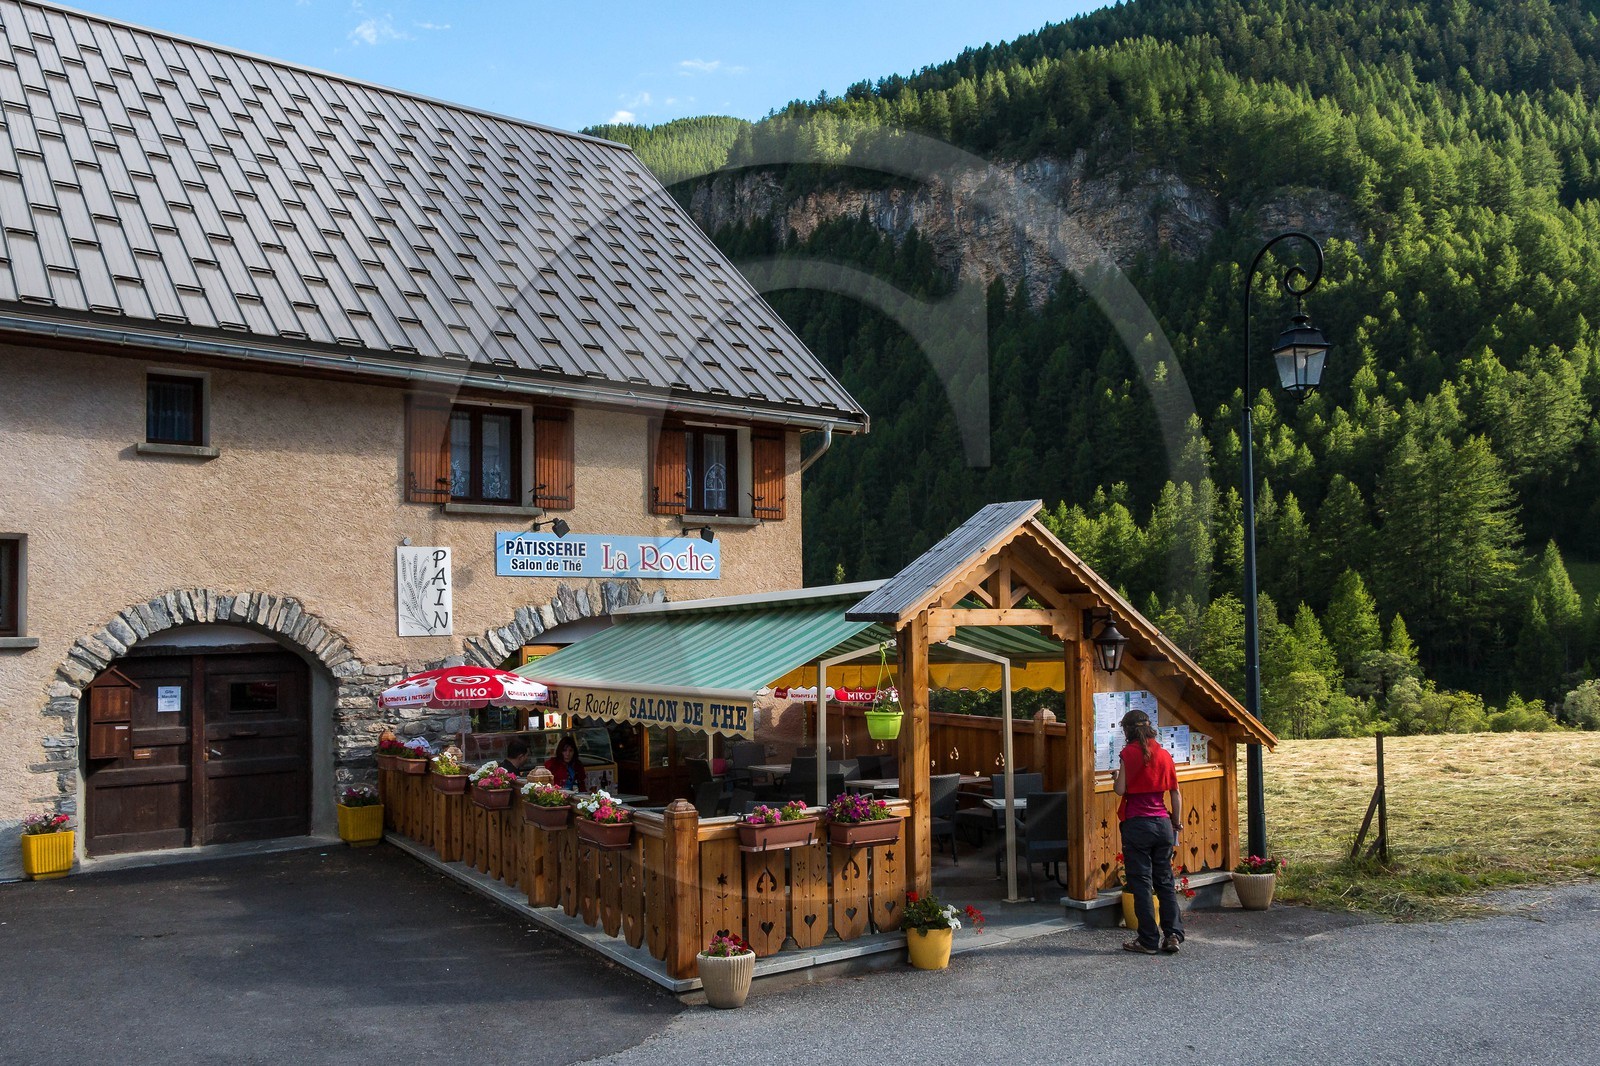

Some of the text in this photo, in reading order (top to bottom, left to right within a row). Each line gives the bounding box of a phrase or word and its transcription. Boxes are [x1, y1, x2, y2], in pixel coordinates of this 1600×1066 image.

[505, 538, 586, 557] PÂTISSERIE
[511, 558, 582, 571] Salon de Thé
[602, 544, 714, 572] La Roche
[431, 549, 448, 628] PAIN
[454, 687, 487, 698] MIKO
[847, 692, 872, 700] MIKO
[567, 692, 581, 712] La
[585, 693, 620, 716] Roche
[629, 697, 678, 723] SALON
[683, 701, 704, 727] DE
[710, 703, 748, 731] THE
